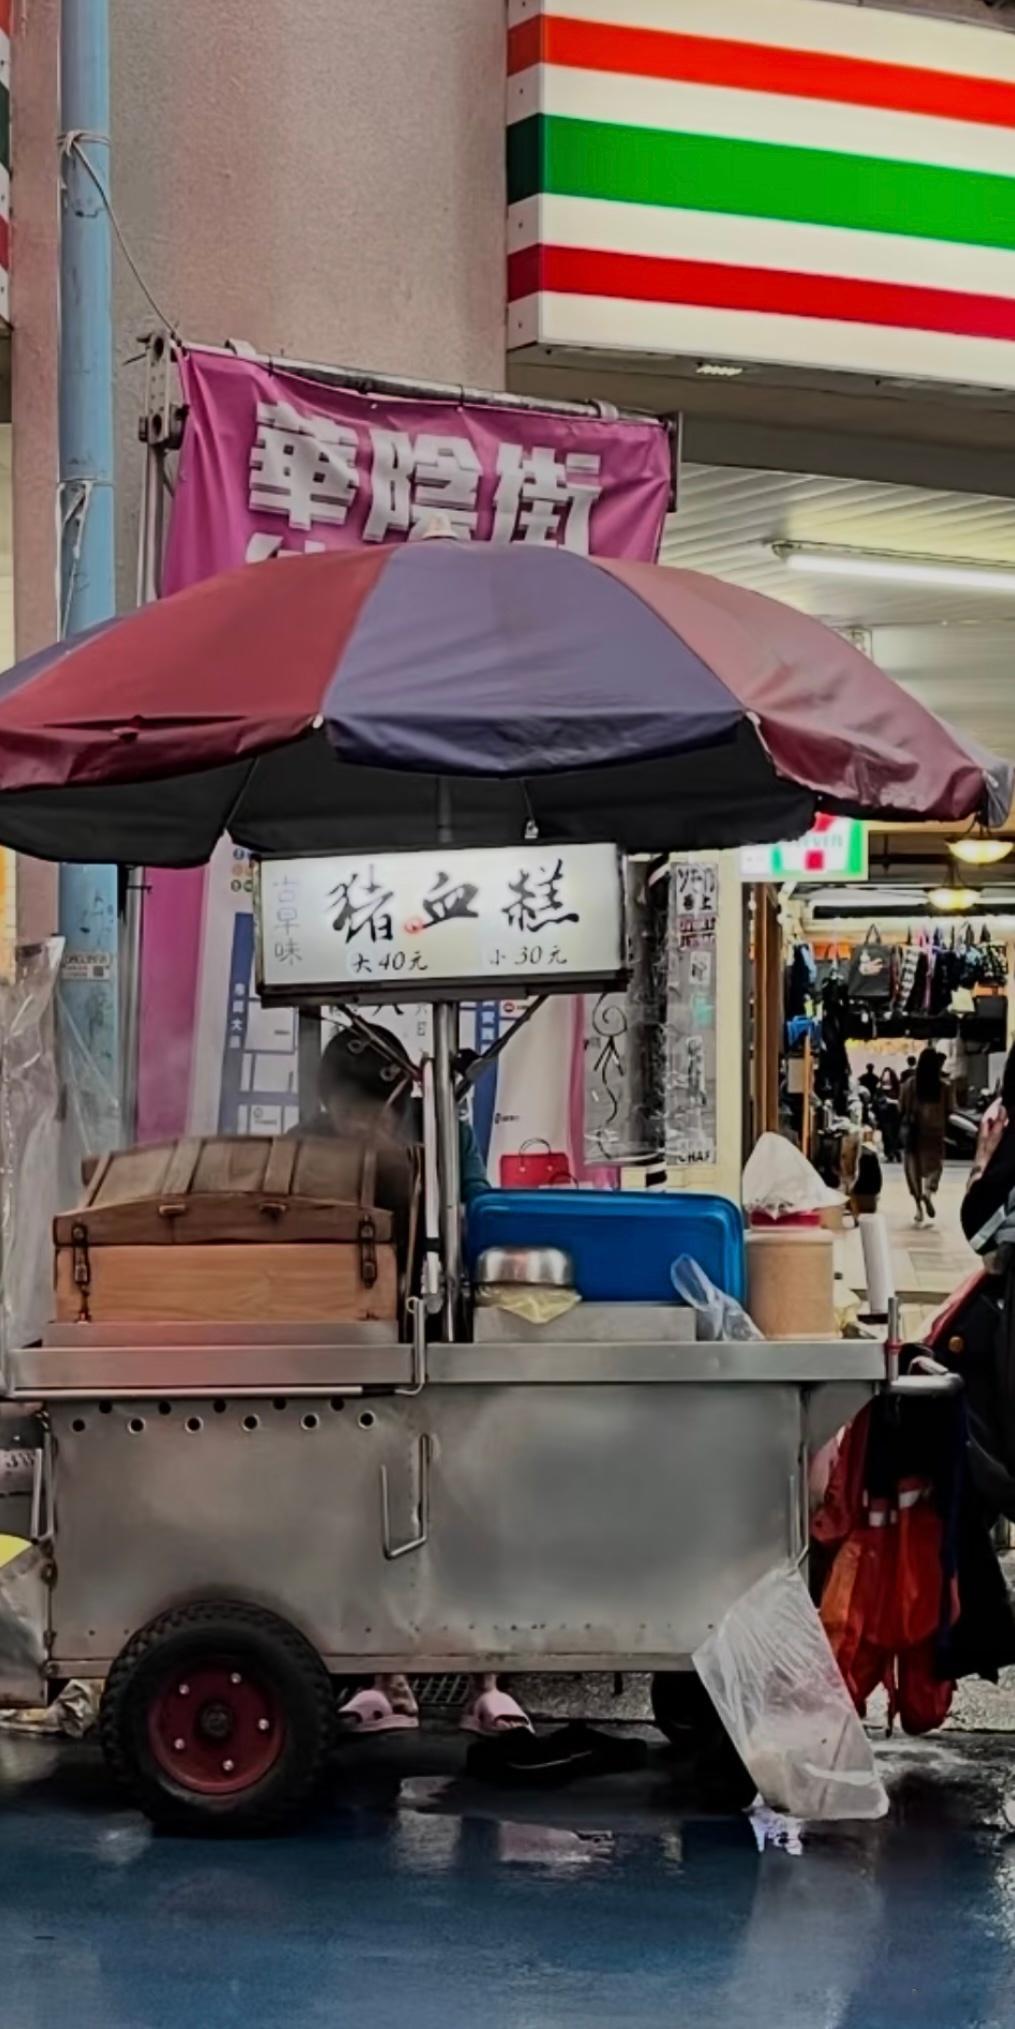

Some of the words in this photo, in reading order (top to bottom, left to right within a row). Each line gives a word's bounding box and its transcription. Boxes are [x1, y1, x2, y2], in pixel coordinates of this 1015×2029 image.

[248, 400, 602, 554] 華陰街
[272, 875, 302, 968] 古早味
